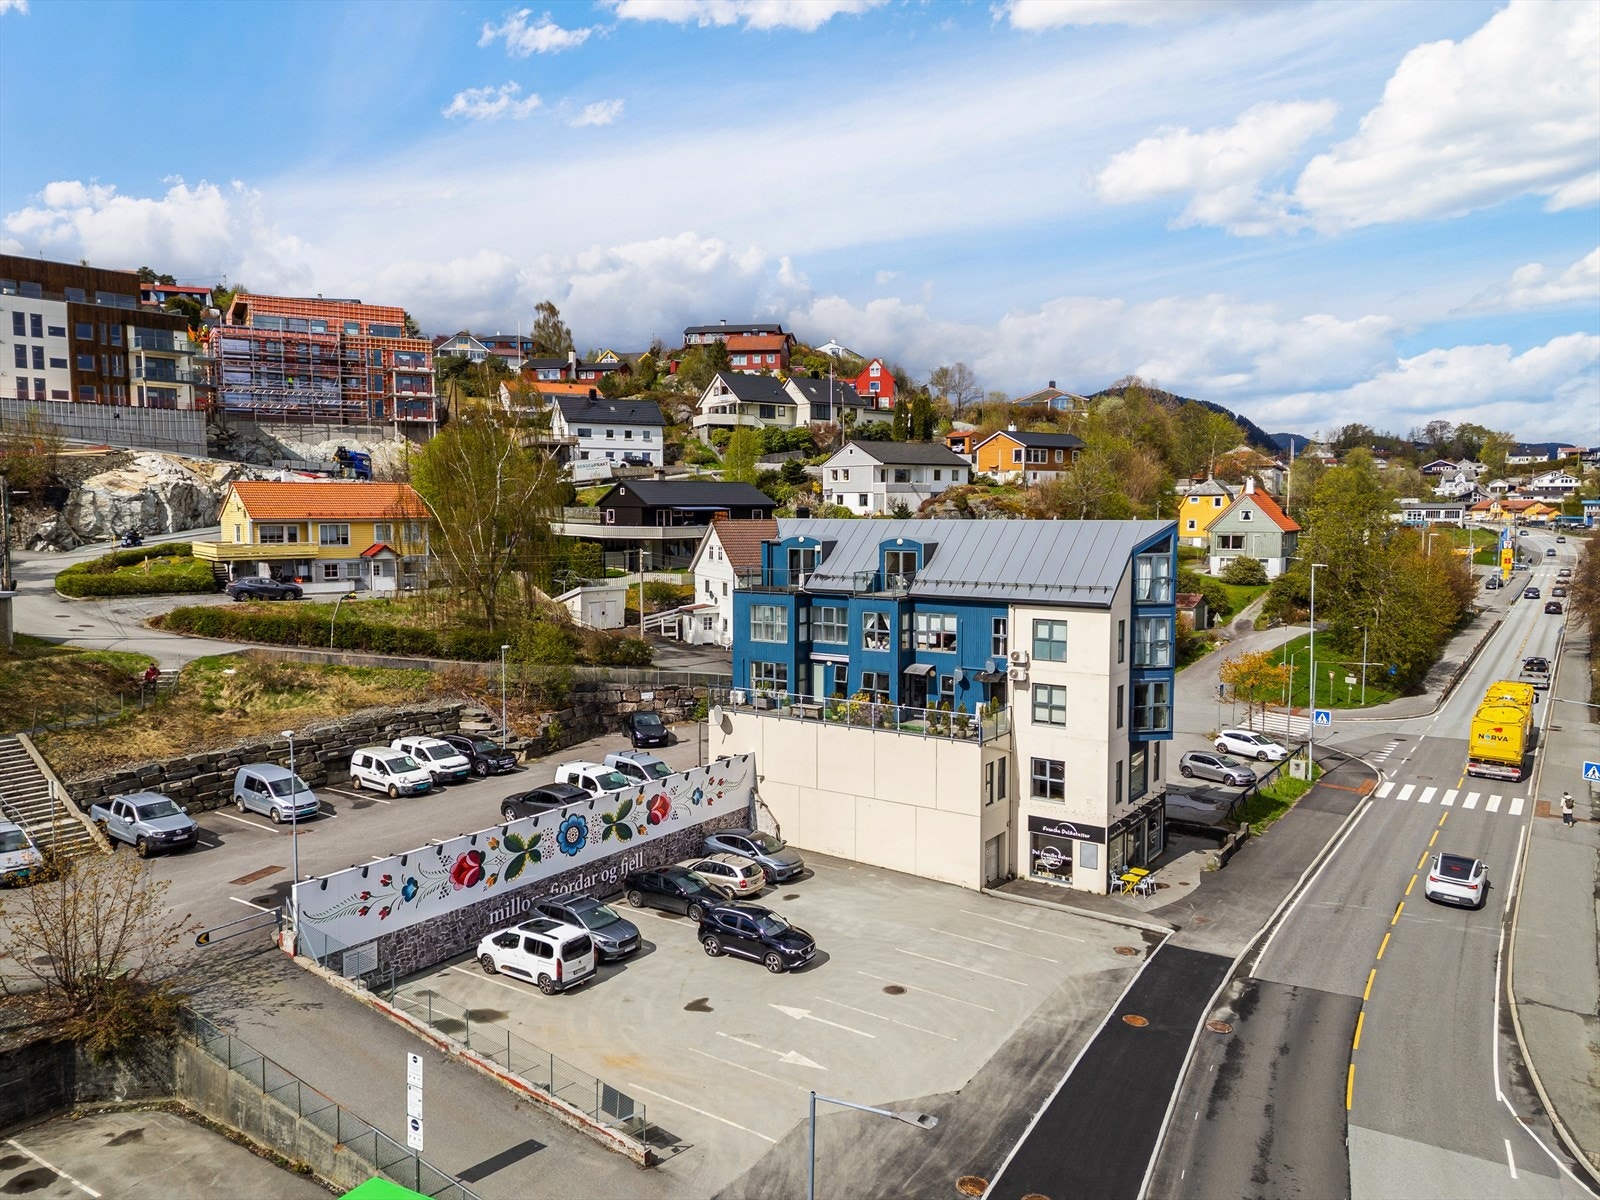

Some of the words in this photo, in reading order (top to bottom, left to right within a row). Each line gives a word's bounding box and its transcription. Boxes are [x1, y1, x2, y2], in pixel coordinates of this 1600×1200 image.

[488, 894, 544, 924] millo
[601, 867, 618, 883] og
[621, 851, 644, 879] fjell
